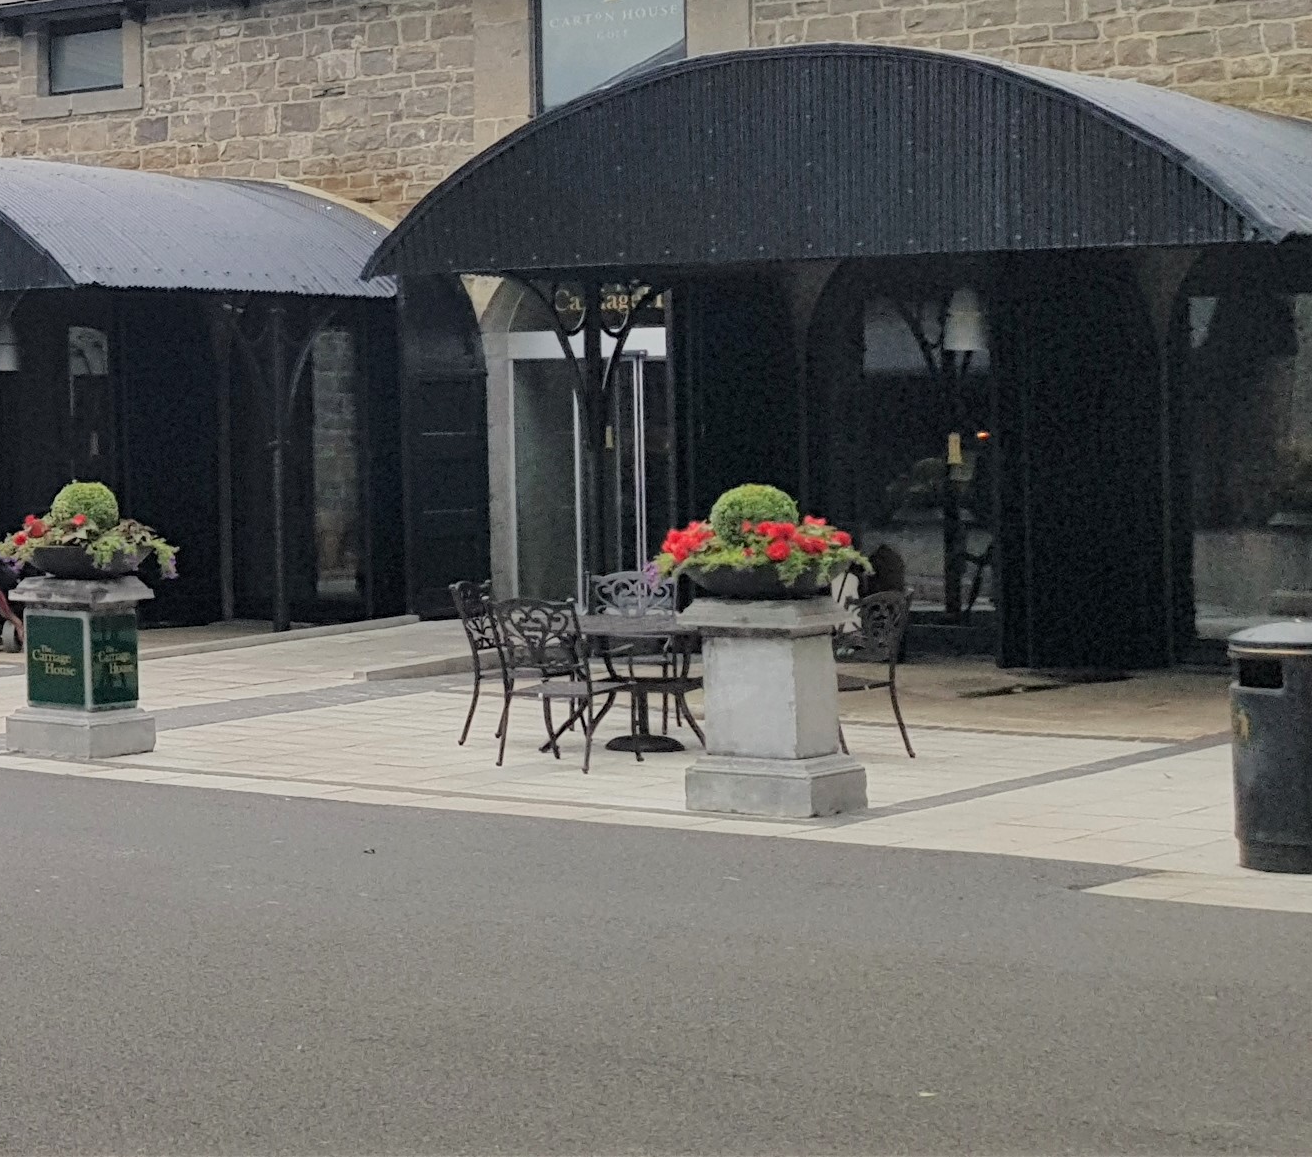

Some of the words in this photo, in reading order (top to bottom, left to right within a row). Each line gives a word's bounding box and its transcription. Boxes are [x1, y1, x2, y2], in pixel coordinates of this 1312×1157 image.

[621, 4, 678, 21] HOUSE
[555, 289, 641, 313] Caage
[32, 648, 72, 665] Carriage
[45, 662, 77, 676] House
